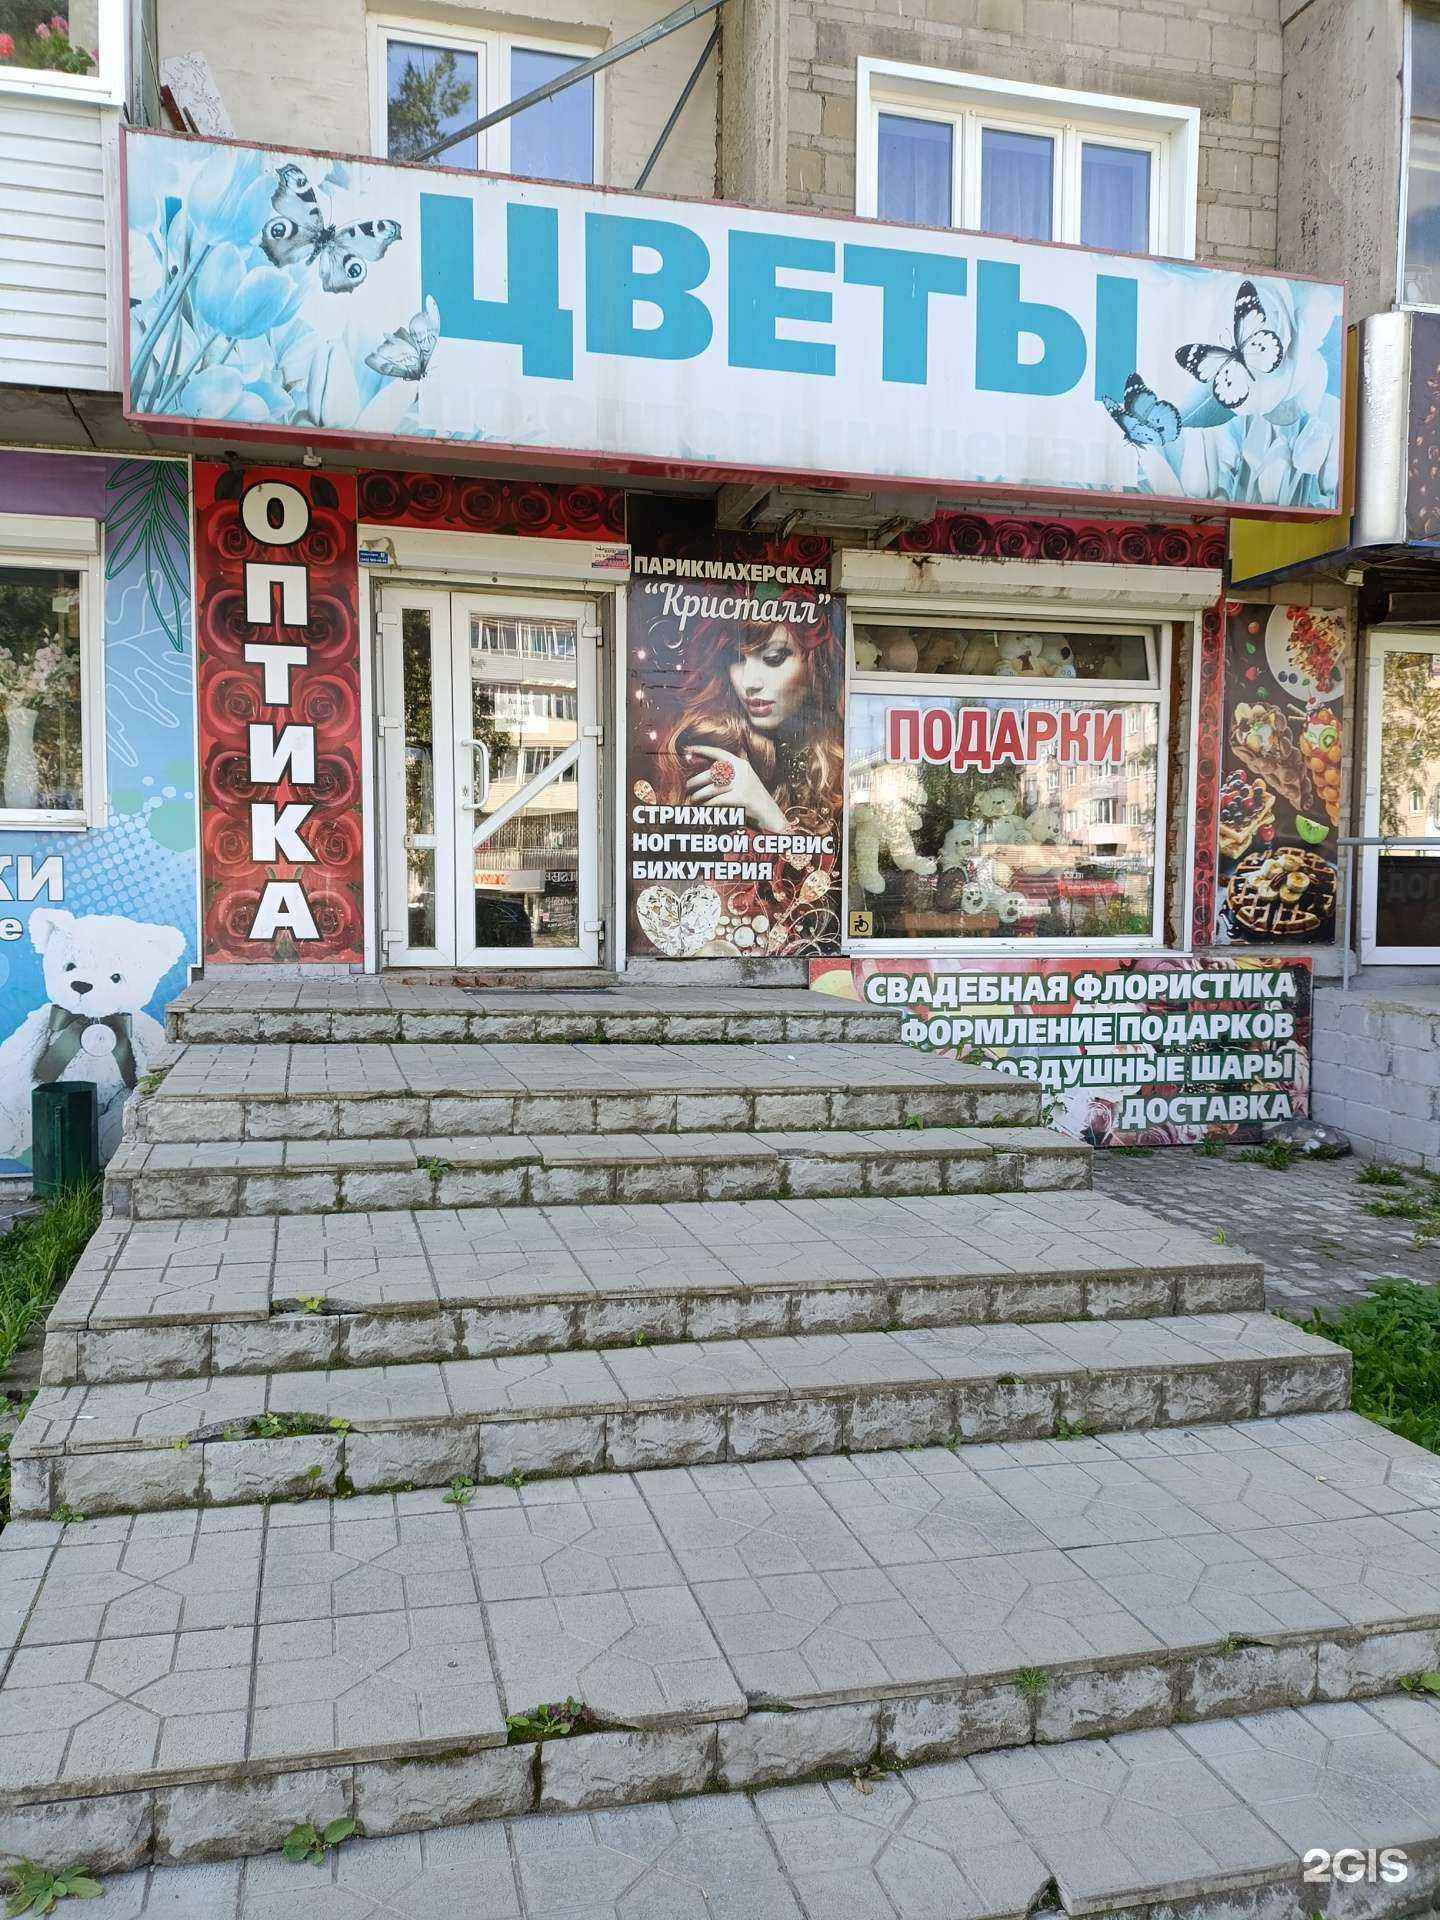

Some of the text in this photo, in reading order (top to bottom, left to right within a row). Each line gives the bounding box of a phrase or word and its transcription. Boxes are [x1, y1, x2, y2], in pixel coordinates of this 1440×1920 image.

[420, 192, 1138, 401] ЦВЕТЫ
[634, 556, 827, 586] ПАРИКМАХЕРСКАЯ
[240, 481, 321, 940] ОПТИКА
[887, 707, 1125, 773] ПОДАРКИ
[632, 806, 745, 826] СТРИЖКИ
[632, 829, 835, 854] НОГТЕВОЙ СЕРВИС
[632, 860, 773, 880] БИЖУТЕРИЯ
[866, 970, 1297, 1006] СВАДЕБНАЯ ФЛОРИСТИКА
[901, 1012, 1294, 1045] ФОРМЛЕНИЕ ПОДАРКОВ
[1192, 1051, 1293, 1081] ШАРЫ
[1121, 1094, 1292, 1130] ДОСТАВКА
